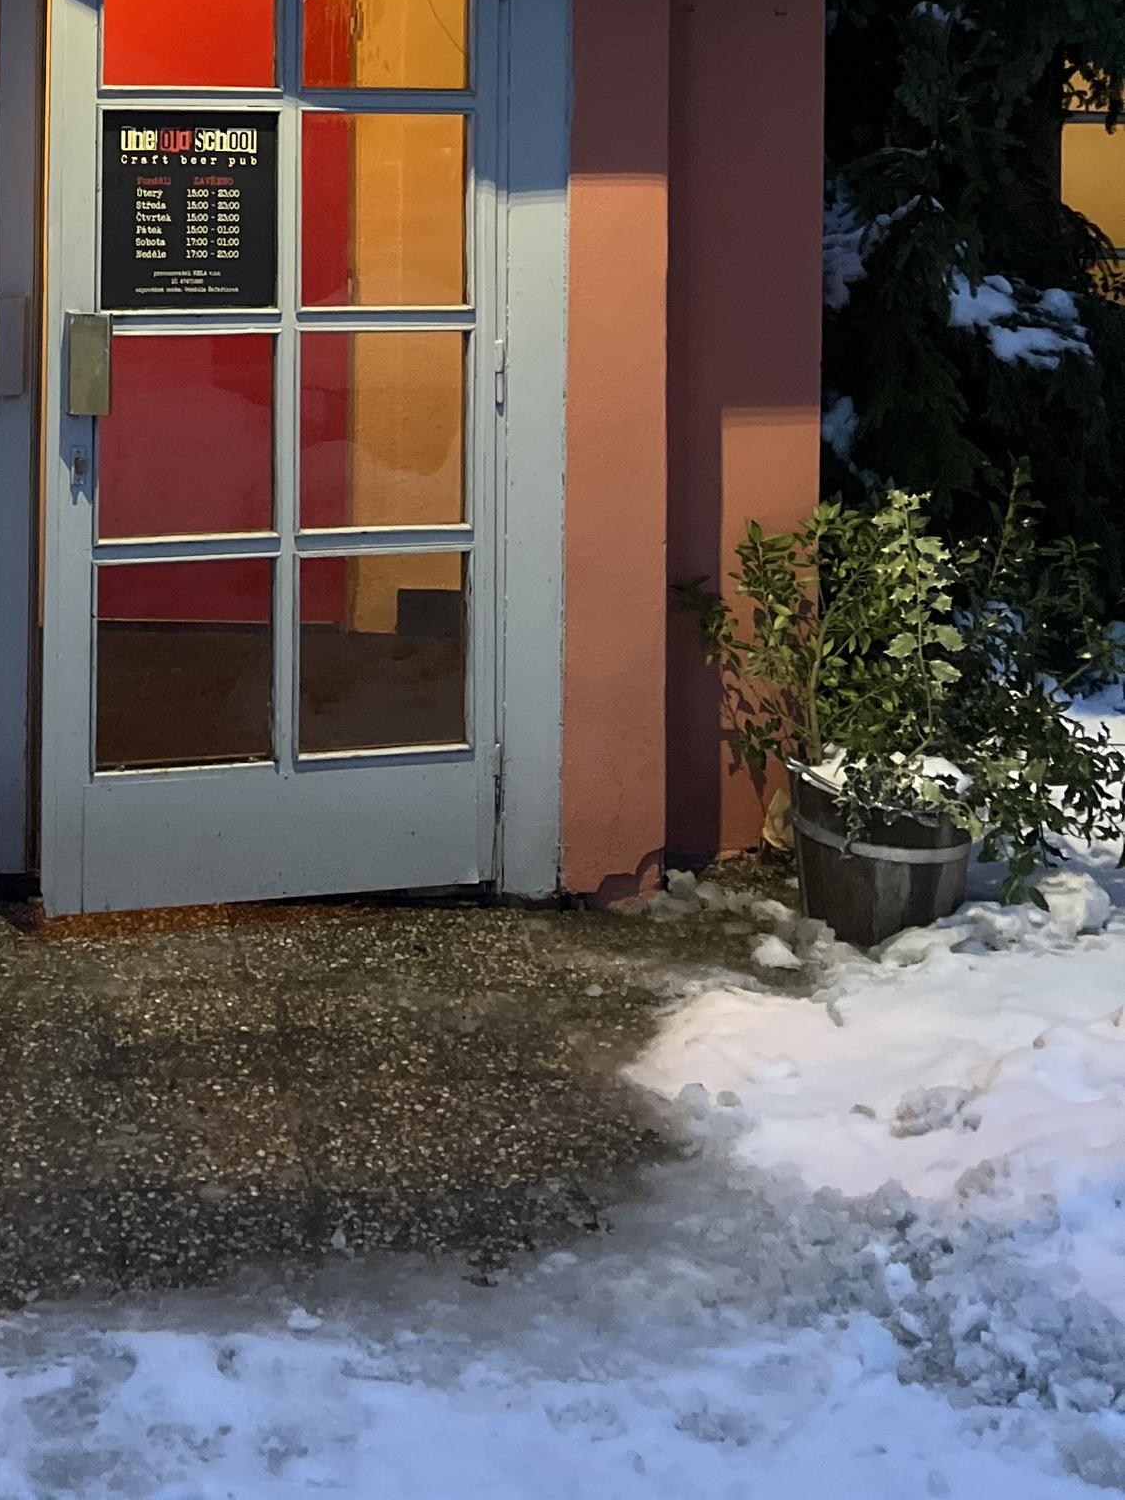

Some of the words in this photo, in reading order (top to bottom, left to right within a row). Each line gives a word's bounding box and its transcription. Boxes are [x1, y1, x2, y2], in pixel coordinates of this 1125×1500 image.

[121, 155, 169, 165] Craft
[180, 155, 217, 165] beer
[228, 156, 257, 167] pub
